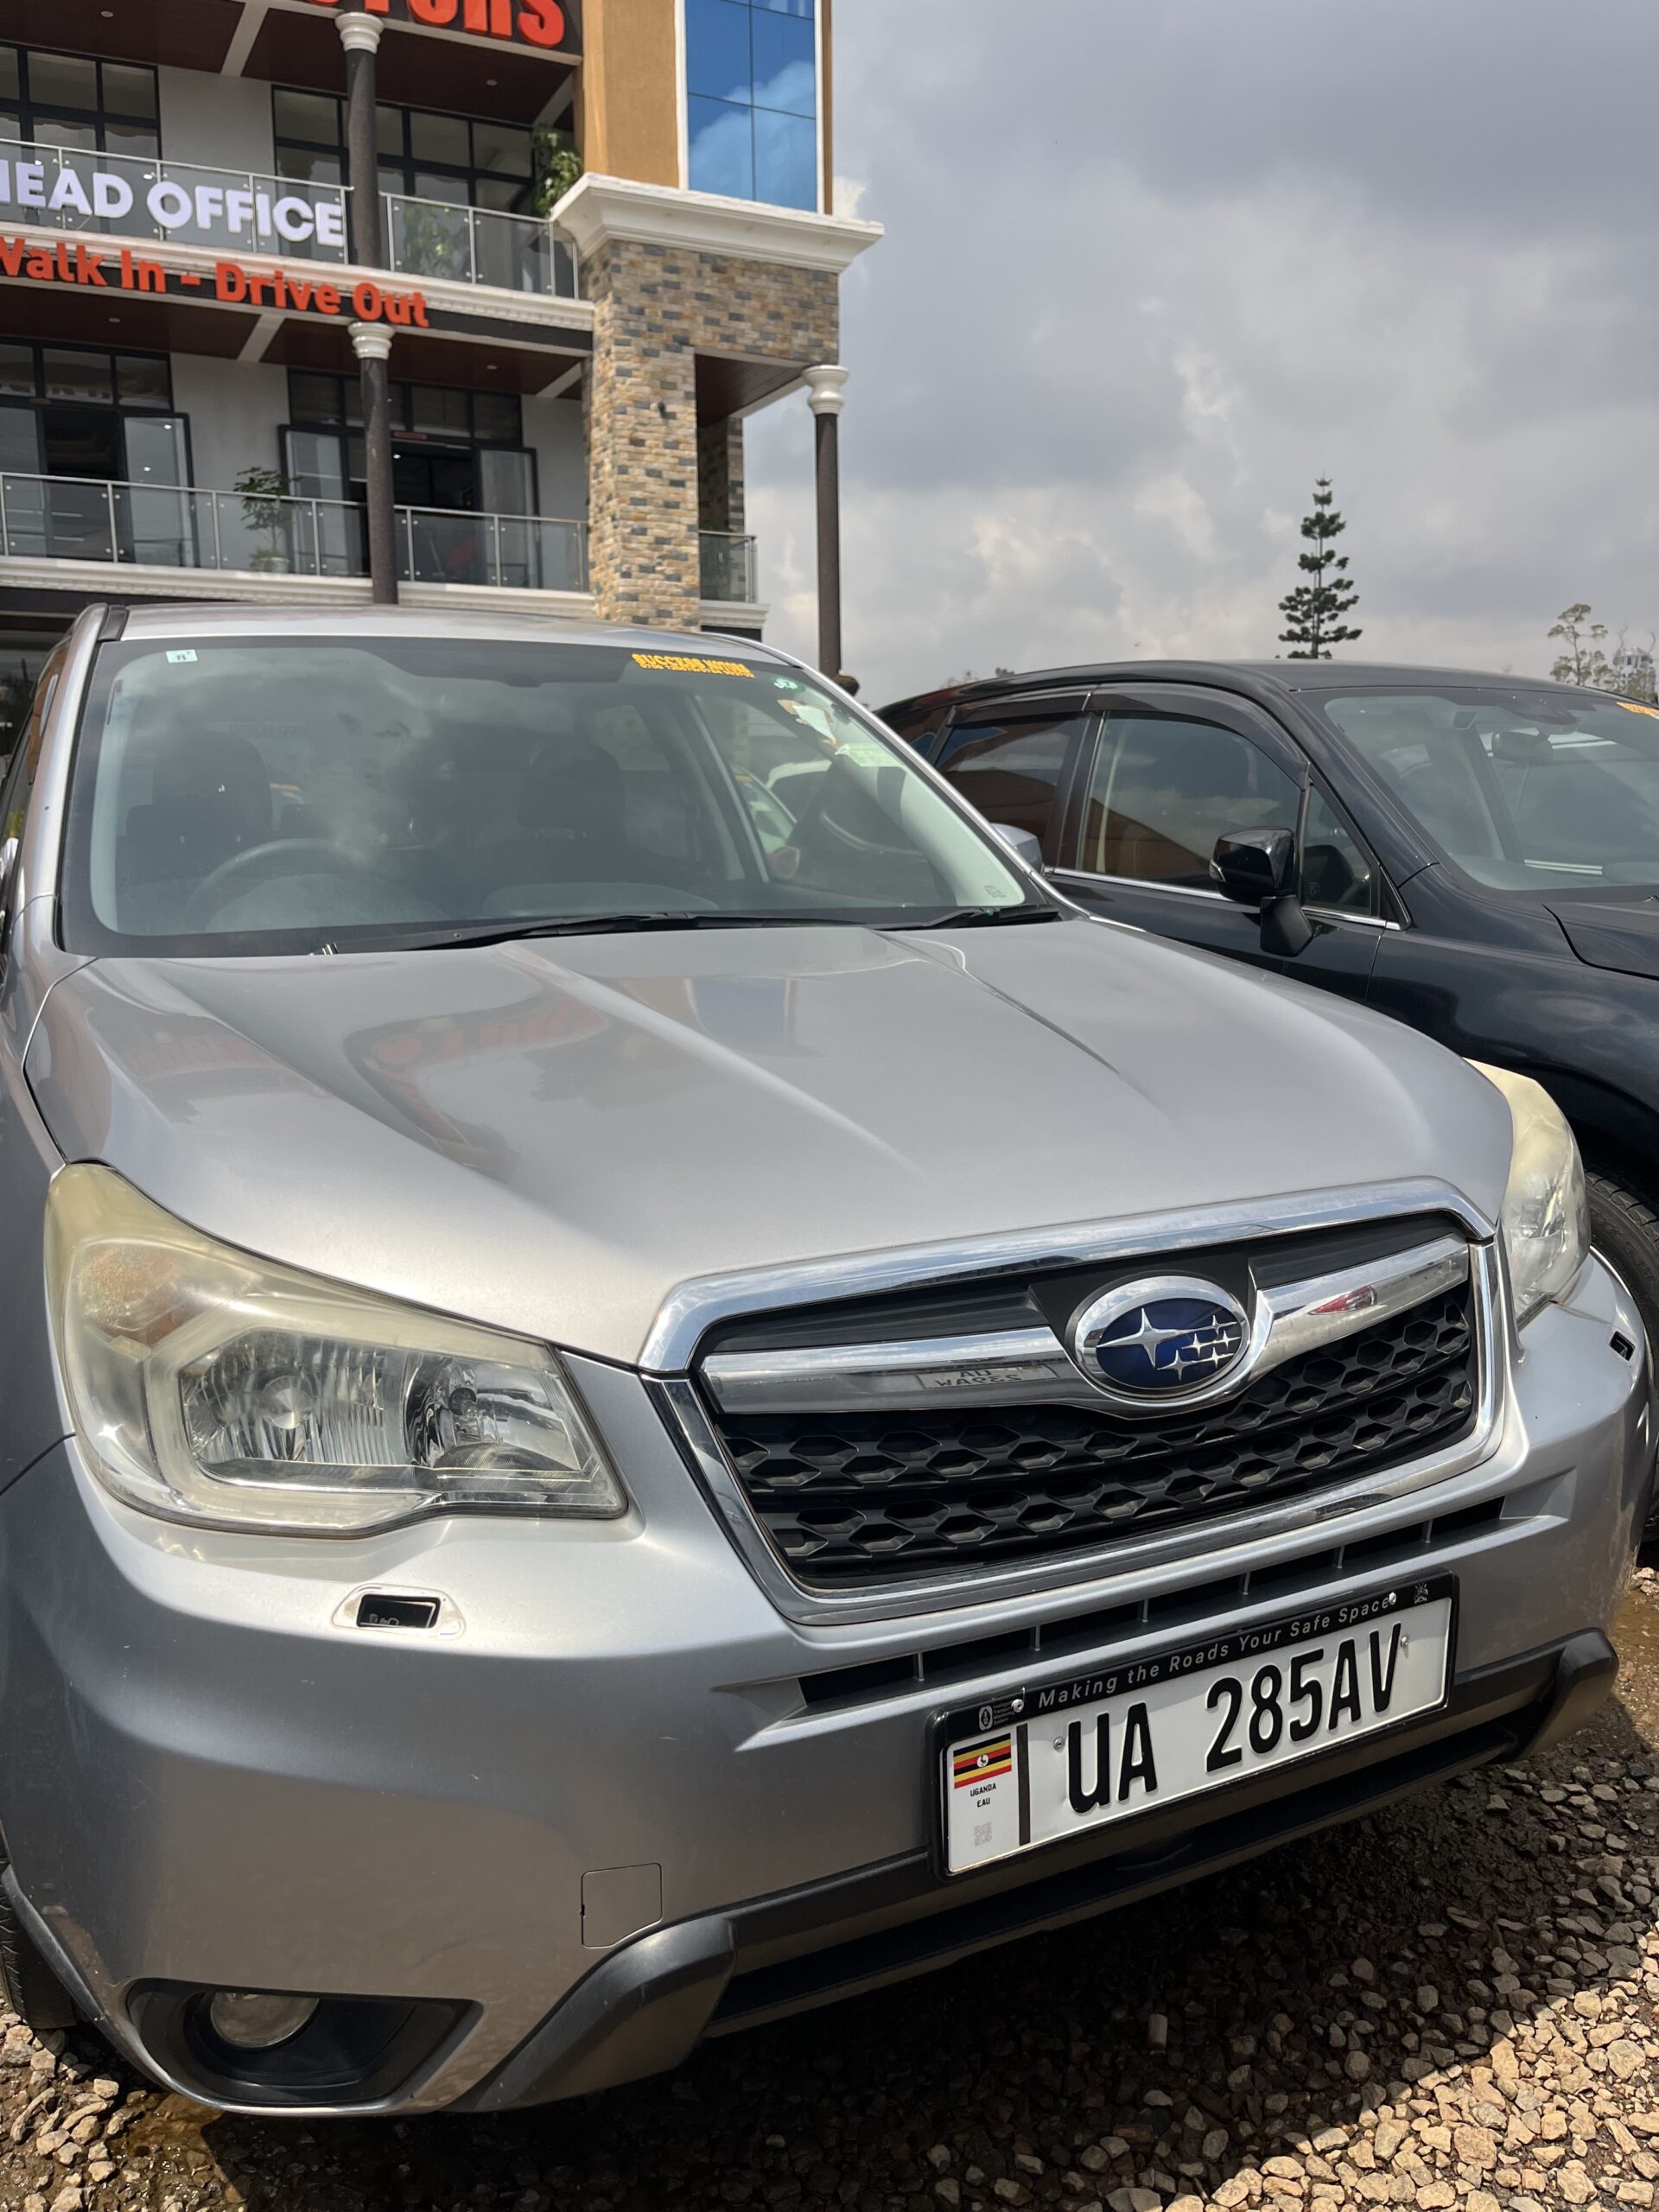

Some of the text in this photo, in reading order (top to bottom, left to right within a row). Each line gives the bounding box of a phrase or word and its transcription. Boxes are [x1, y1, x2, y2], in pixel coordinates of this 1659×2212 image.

[146, 181, 345, 247] OFFICE
[121, 250, 166, 294] In
[181, 274, 200, 286] -
[216, 262, 341, 315] Drive
[353, 283, 429, 328] Out
[1038, 1596, 1389, 1708] Making the Roads Your Safe Space
[1066, 1622, 1402, 1814] UA 285AV
[969, 1783, 997, 1797] UGANDA
[976, 1797, 991, 1808] EAU
